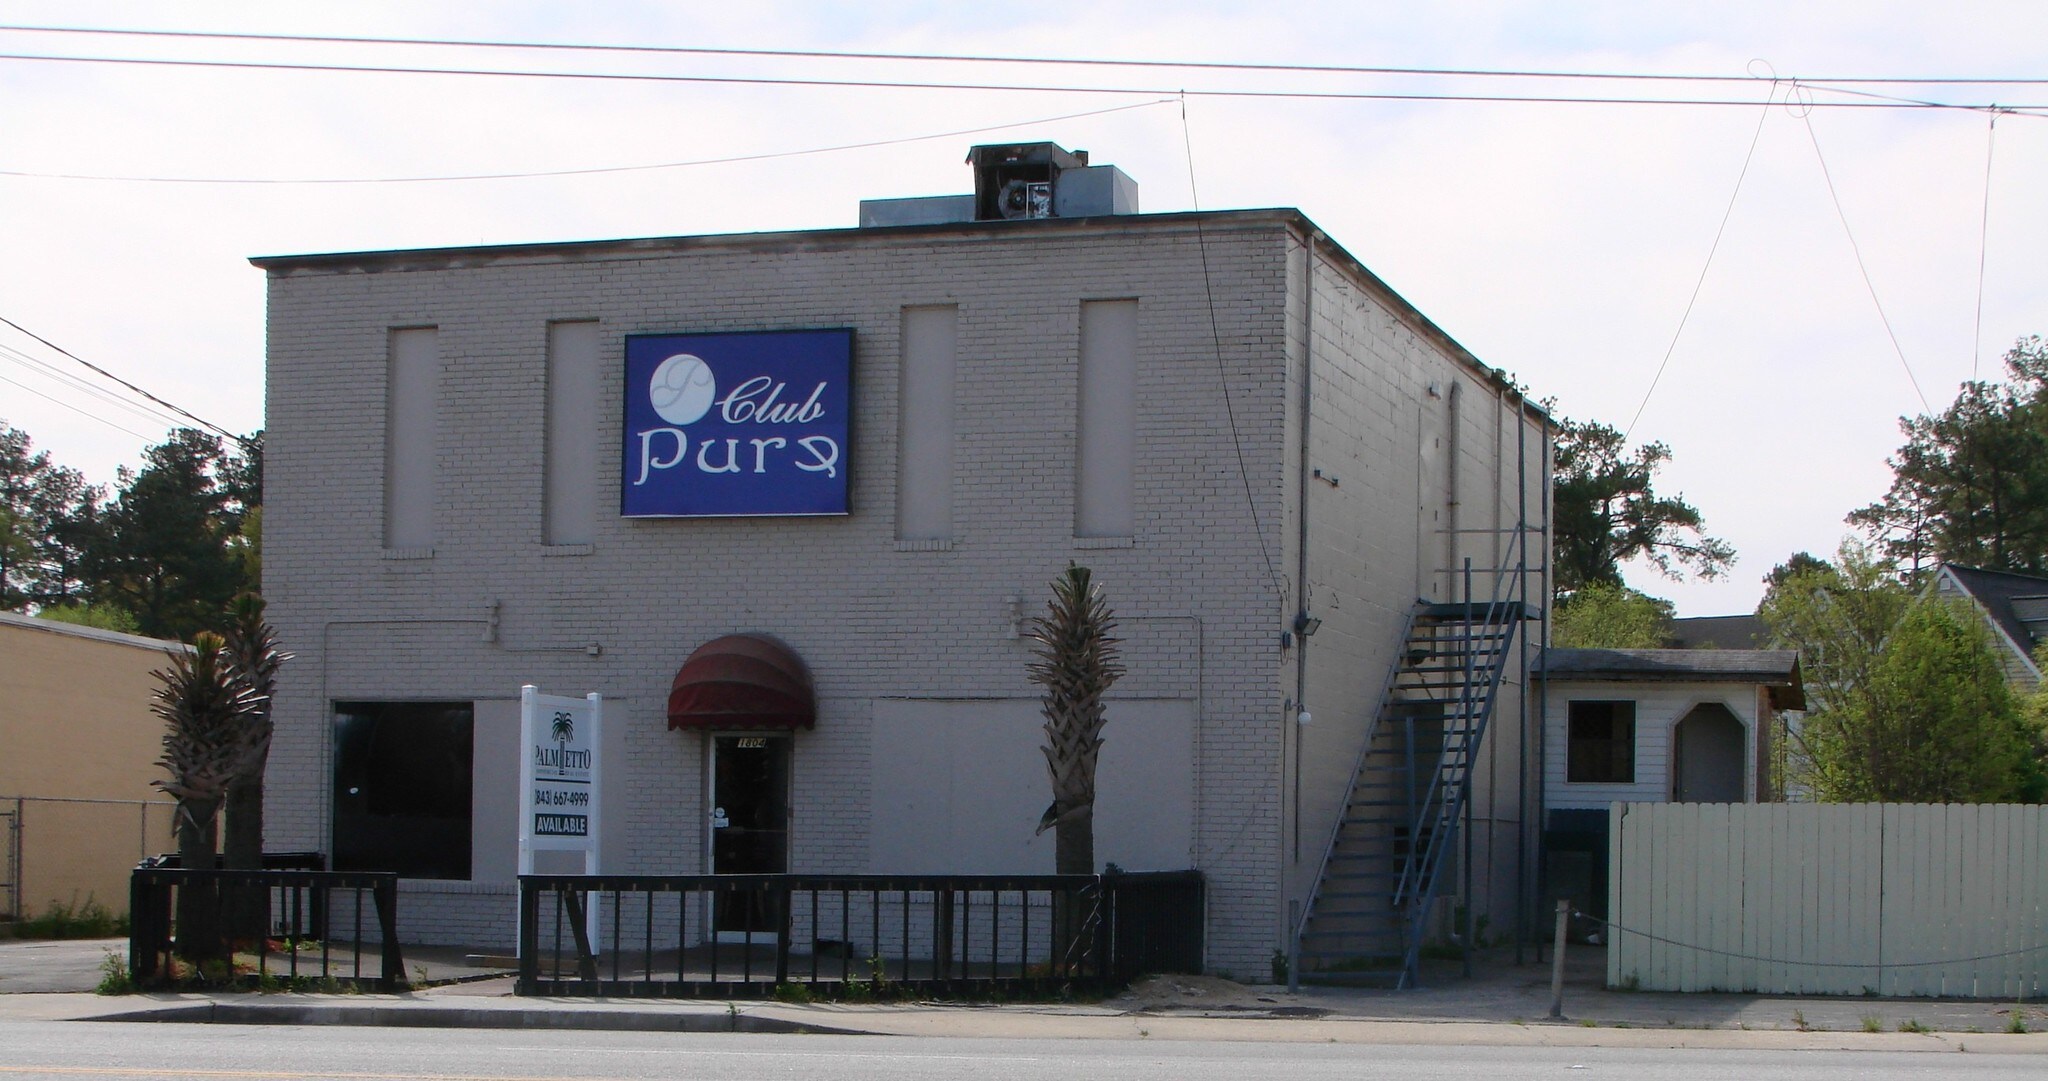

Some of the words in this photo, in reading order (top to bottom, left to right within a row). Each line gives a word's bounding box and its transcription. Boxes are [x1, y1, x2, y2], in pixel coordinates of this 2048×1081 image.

[715, 376, 827, 424] Club
[737, 737, 767, 748] 1804
[553, 791, 589, 806] 667-4999
[536, 816, 585, 833] AVAILABLE
